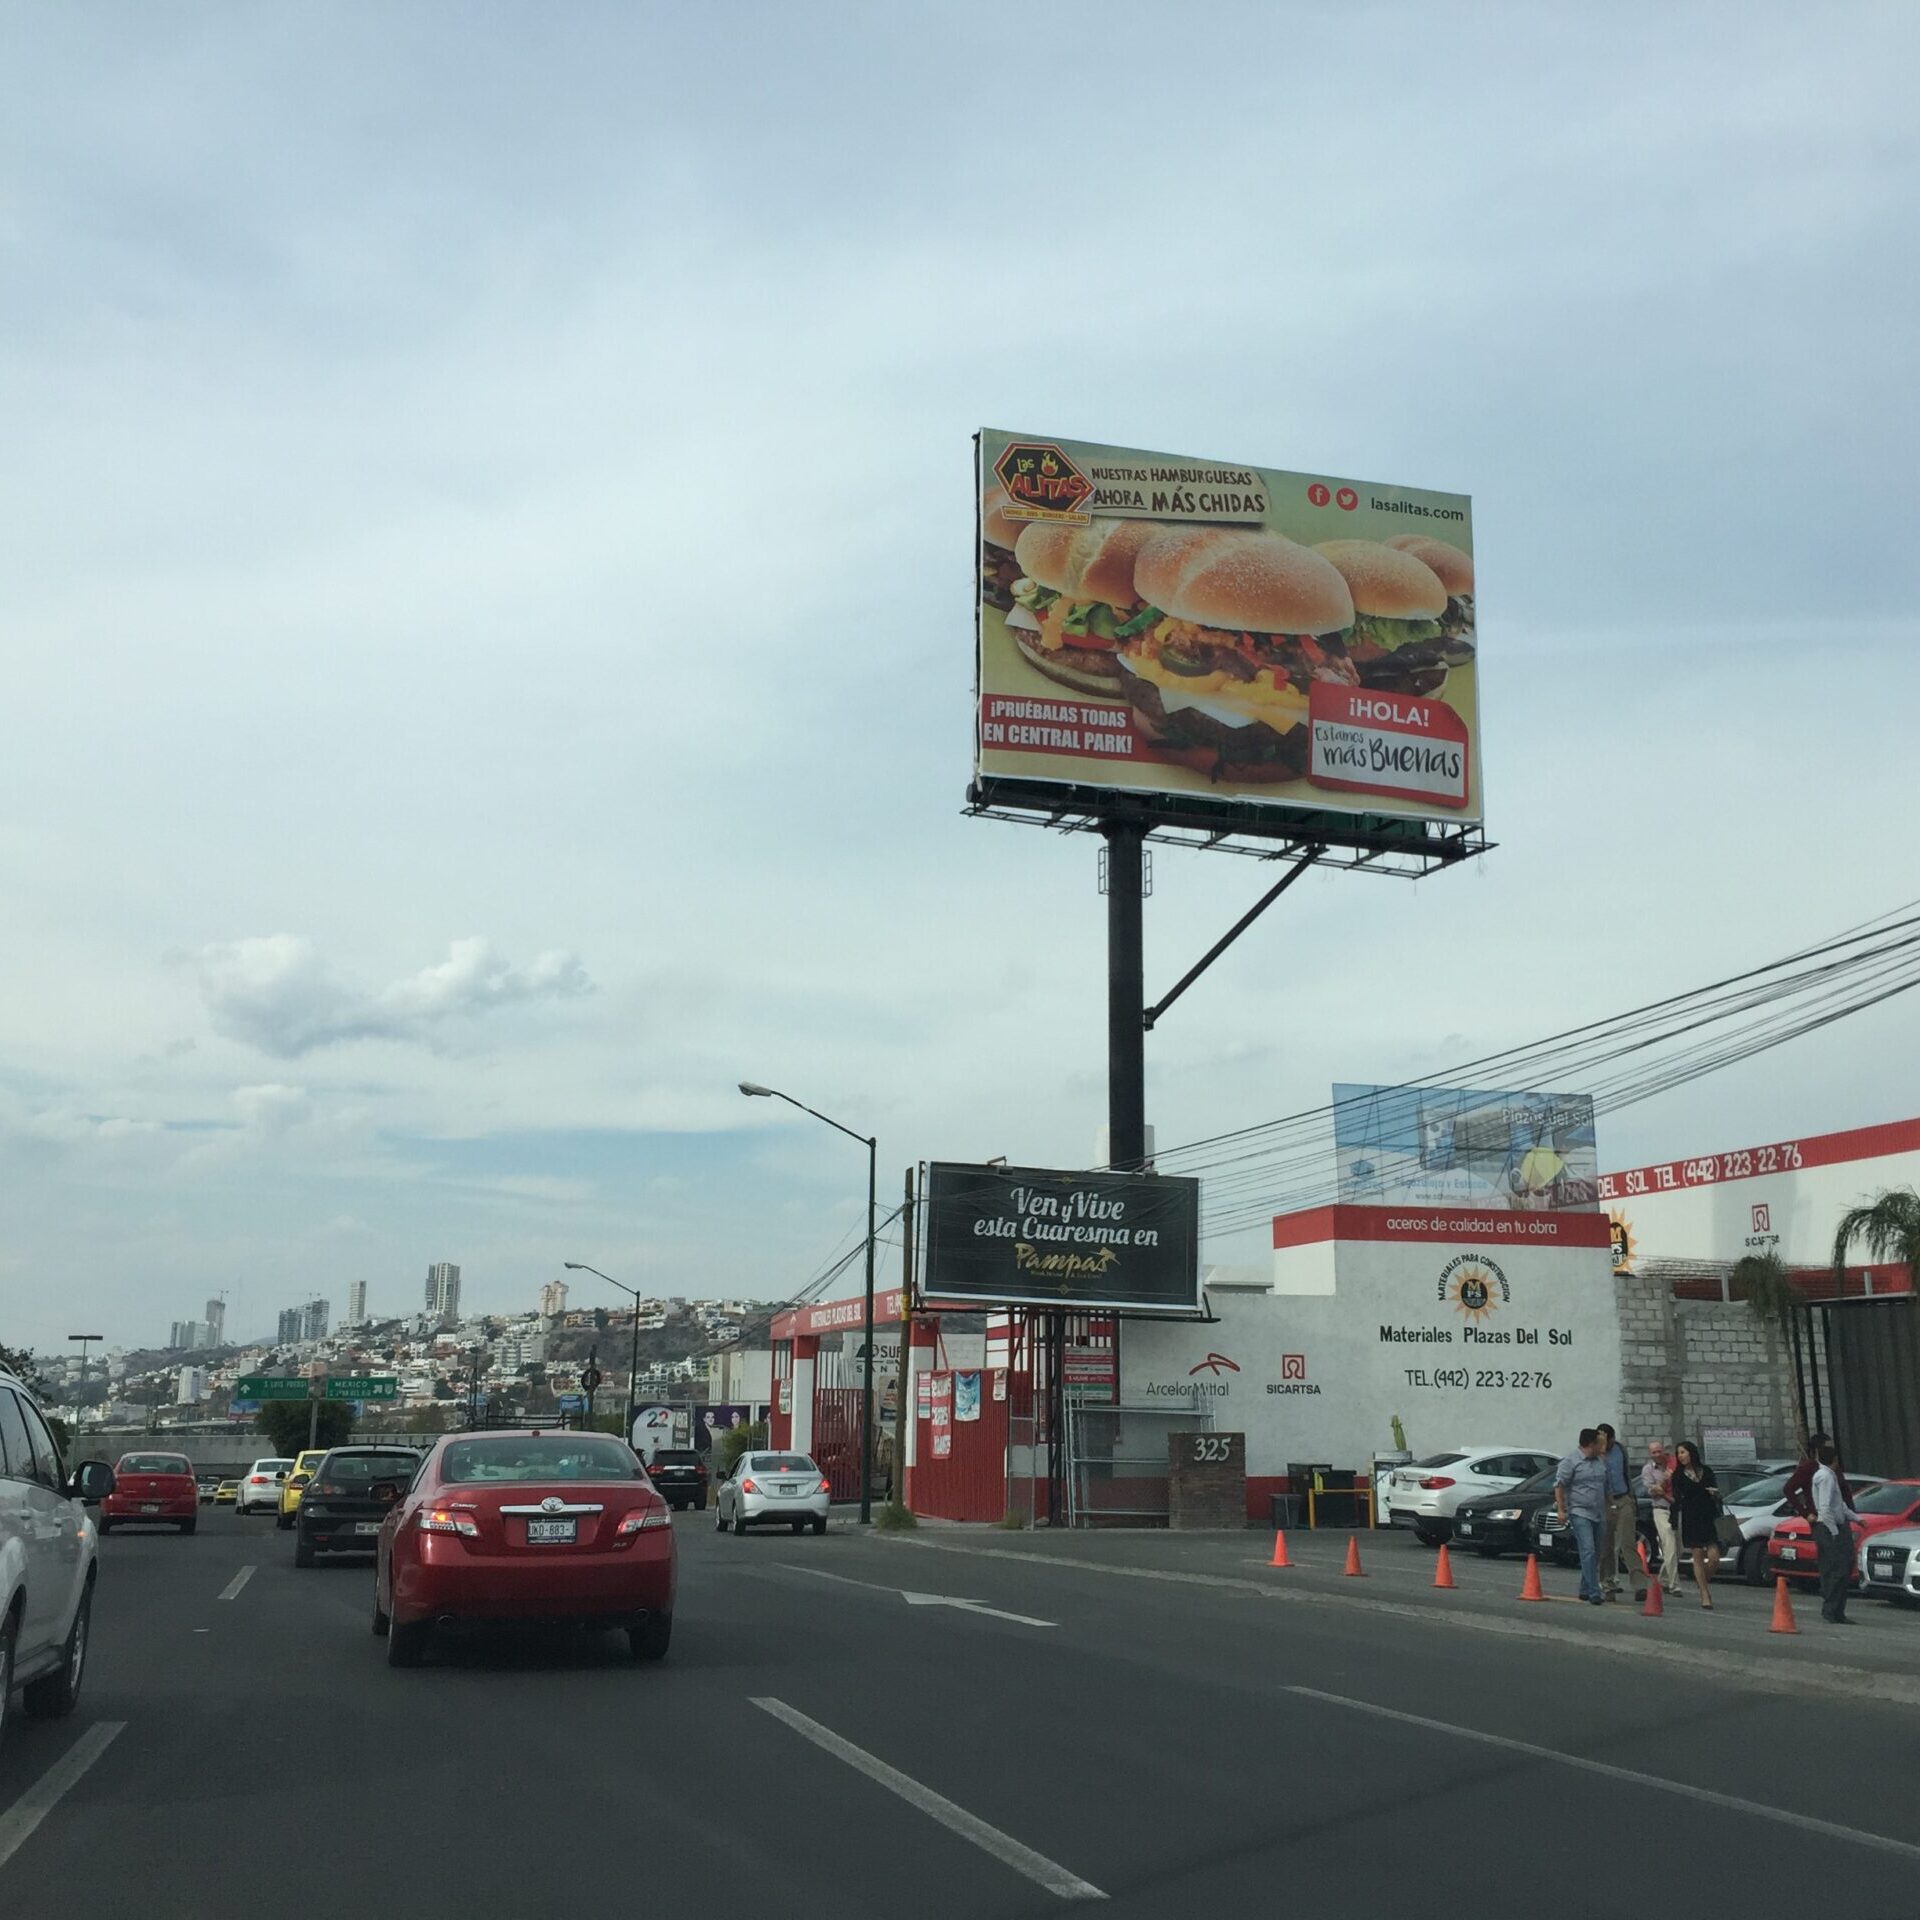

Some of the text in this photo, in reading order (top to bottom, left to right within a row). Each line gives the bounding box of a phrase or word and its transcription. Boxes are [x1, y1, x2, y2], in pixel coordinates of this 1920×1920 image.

[1008, 473, 1088, 500] ALITAS
[1091, 467, 1253, 486] NUESTRAS HAMBURGUESAS
[1093, 484, 1266, 513] AHORA MÁS CHIDAS
[1371, 496, 1464, 521] lasalitas.com
[990, 700, 1126, 728] ¡PRUÉBALAS TODAS
[1350, 698, 1430, 727] ¡HOLA!
[983, 723, 1133, 754] EN CENTRAL PARK!
[1315, 725, 1364, 744] Estamos
[1323, 738, 1461, 779] más Buenas
[1597, 1177, 1619, 1198] DEL
[1625, 1169, 1649, 1193] SOL
[1010, 1186, 1126, 1223] Ven y Vive
[973, 1216, 1159, 1246] esta Cuaresma en
[1386, 1215, 1558, 1235] aceros de calidad en tu obra
[1014, 1242, 1121, 1278] Pampas
[1437, 1256, 1462, 1302] MATERIALES
[1460, 1253, 1480, 1264] PARA
[1379, 1325, 1572, 1346] Materiales Plazas Del Sol
[1266, 1383, 1322, 1395] SICARTSA
[647, 1410, 669, 1428] 22
[1194, 1436, 1232, 1462] 325
